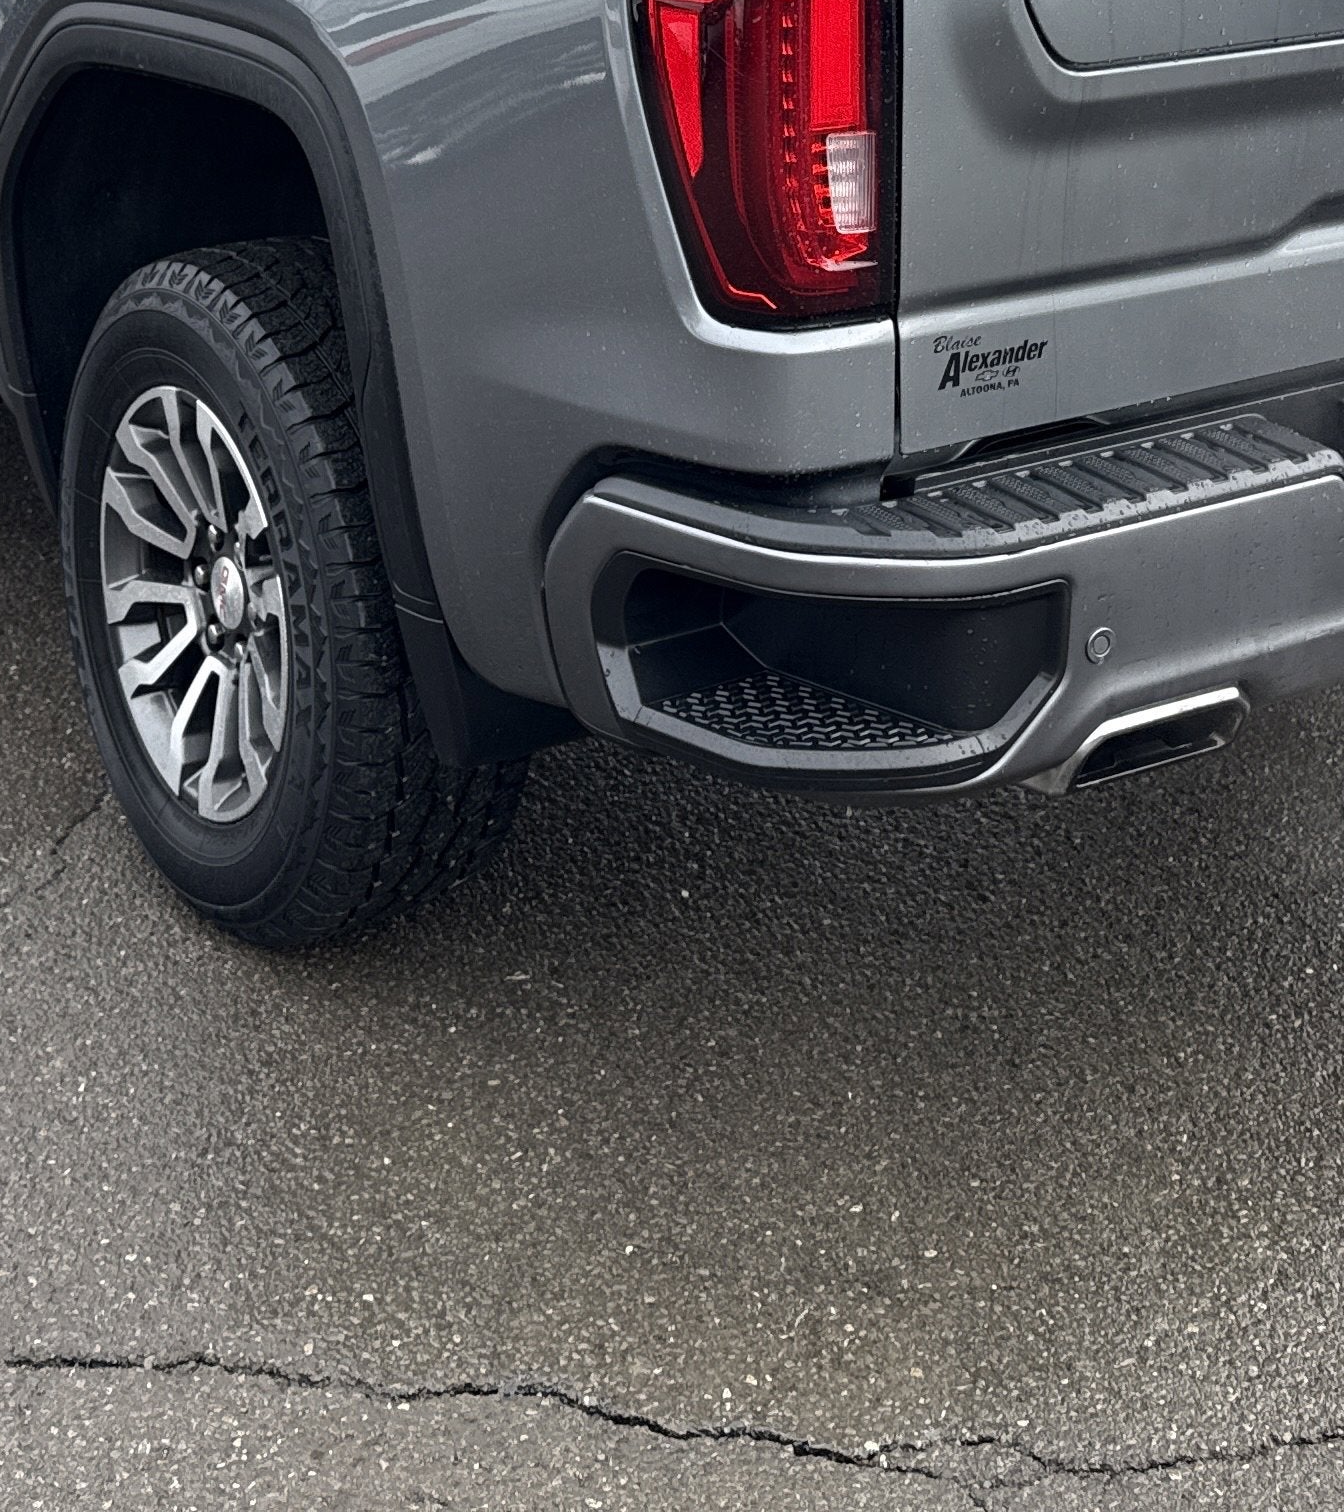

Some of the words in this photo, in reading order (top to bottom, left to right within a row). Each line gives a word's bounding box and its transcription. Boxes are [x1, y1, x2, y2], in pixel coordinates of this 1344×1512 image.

[938, 339, 1048, 390] Alexander
[1007, 378, 1020, 388] PA
[237, 400, 313, 738] TERRAMAX
